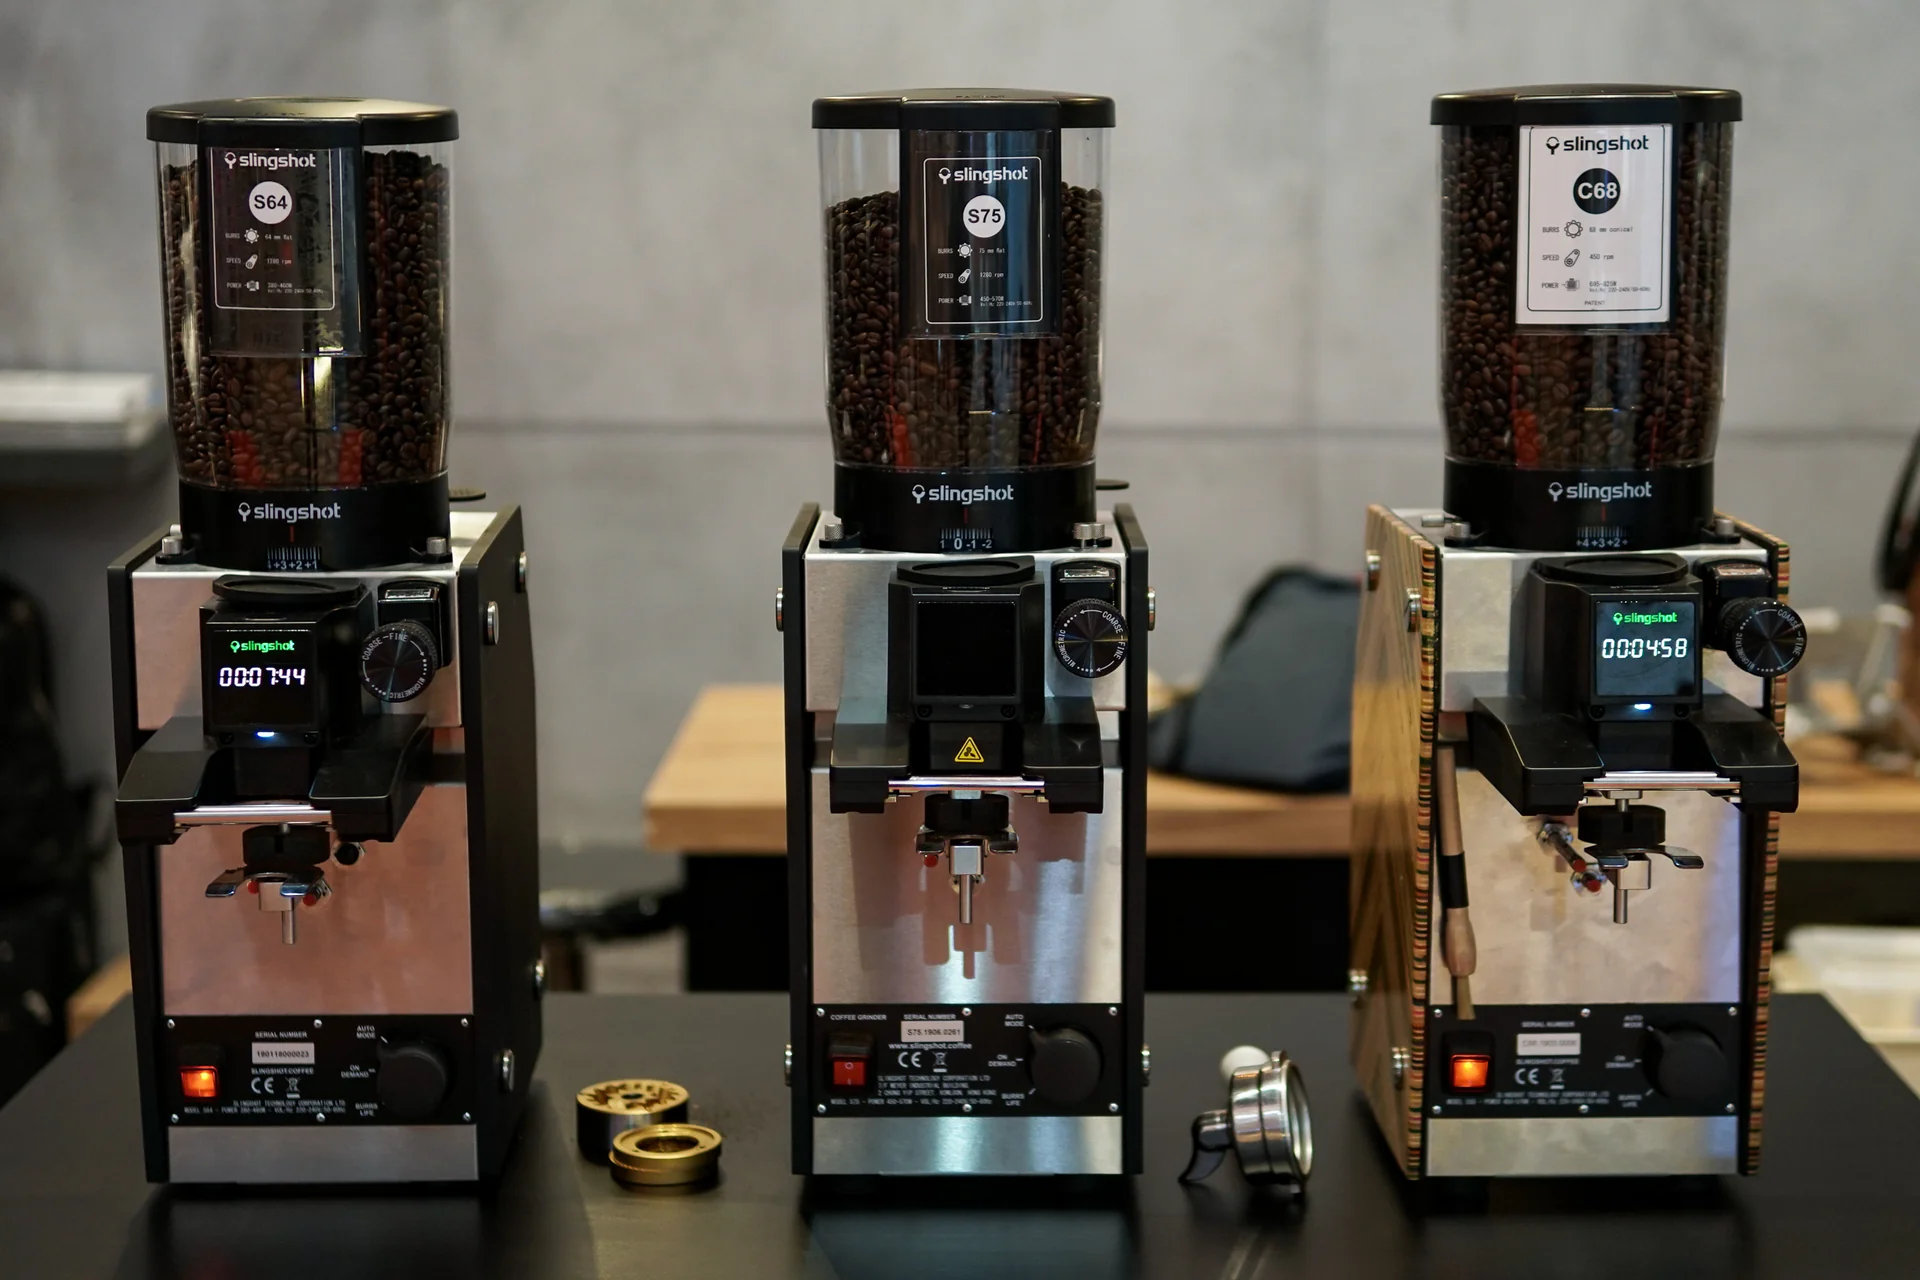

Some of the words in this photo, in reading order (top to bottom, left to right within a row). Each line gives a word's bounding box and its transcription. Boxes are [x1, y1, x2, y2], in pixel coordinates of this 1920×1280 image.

[1563, 135, 1649, 155] slingshot
[239, 152, 316, 171] slingshot
[954, 166, 1028, 184] slingshot
[1577, 182, 1618, 200] C68
[254, 195, 288, 210] S64
[968, 208, 1001, 223] S75
[928, 484, 1014, 505] slingshot
[1566, 481, 1652, 502] slingshot
[254, 502, 341, 523] slingshot
[953, 538, 962, 550] 0
[1624, 612, 1678, 625] slingshot
[1777, 608, 1804, 631] COARSE
[1102, 610, 1124, 634] COARSE
[1113, 641, 1126, 660] FINE
[241, 640, 295, 652] slingshot
[361, 637, 383, 661] COARSE
[388, 632, 409, 642] FINE
[1058, 629, 1077, 668] MICROMETRIC
[1601, 638, 1688, 659] 00:04:58
[219, 667, 306, 687] 00:07:44
[389, 677, 426, 699] MICROMETRIC
[888, 1043, 973, 1051] www.slingshot.coffee
